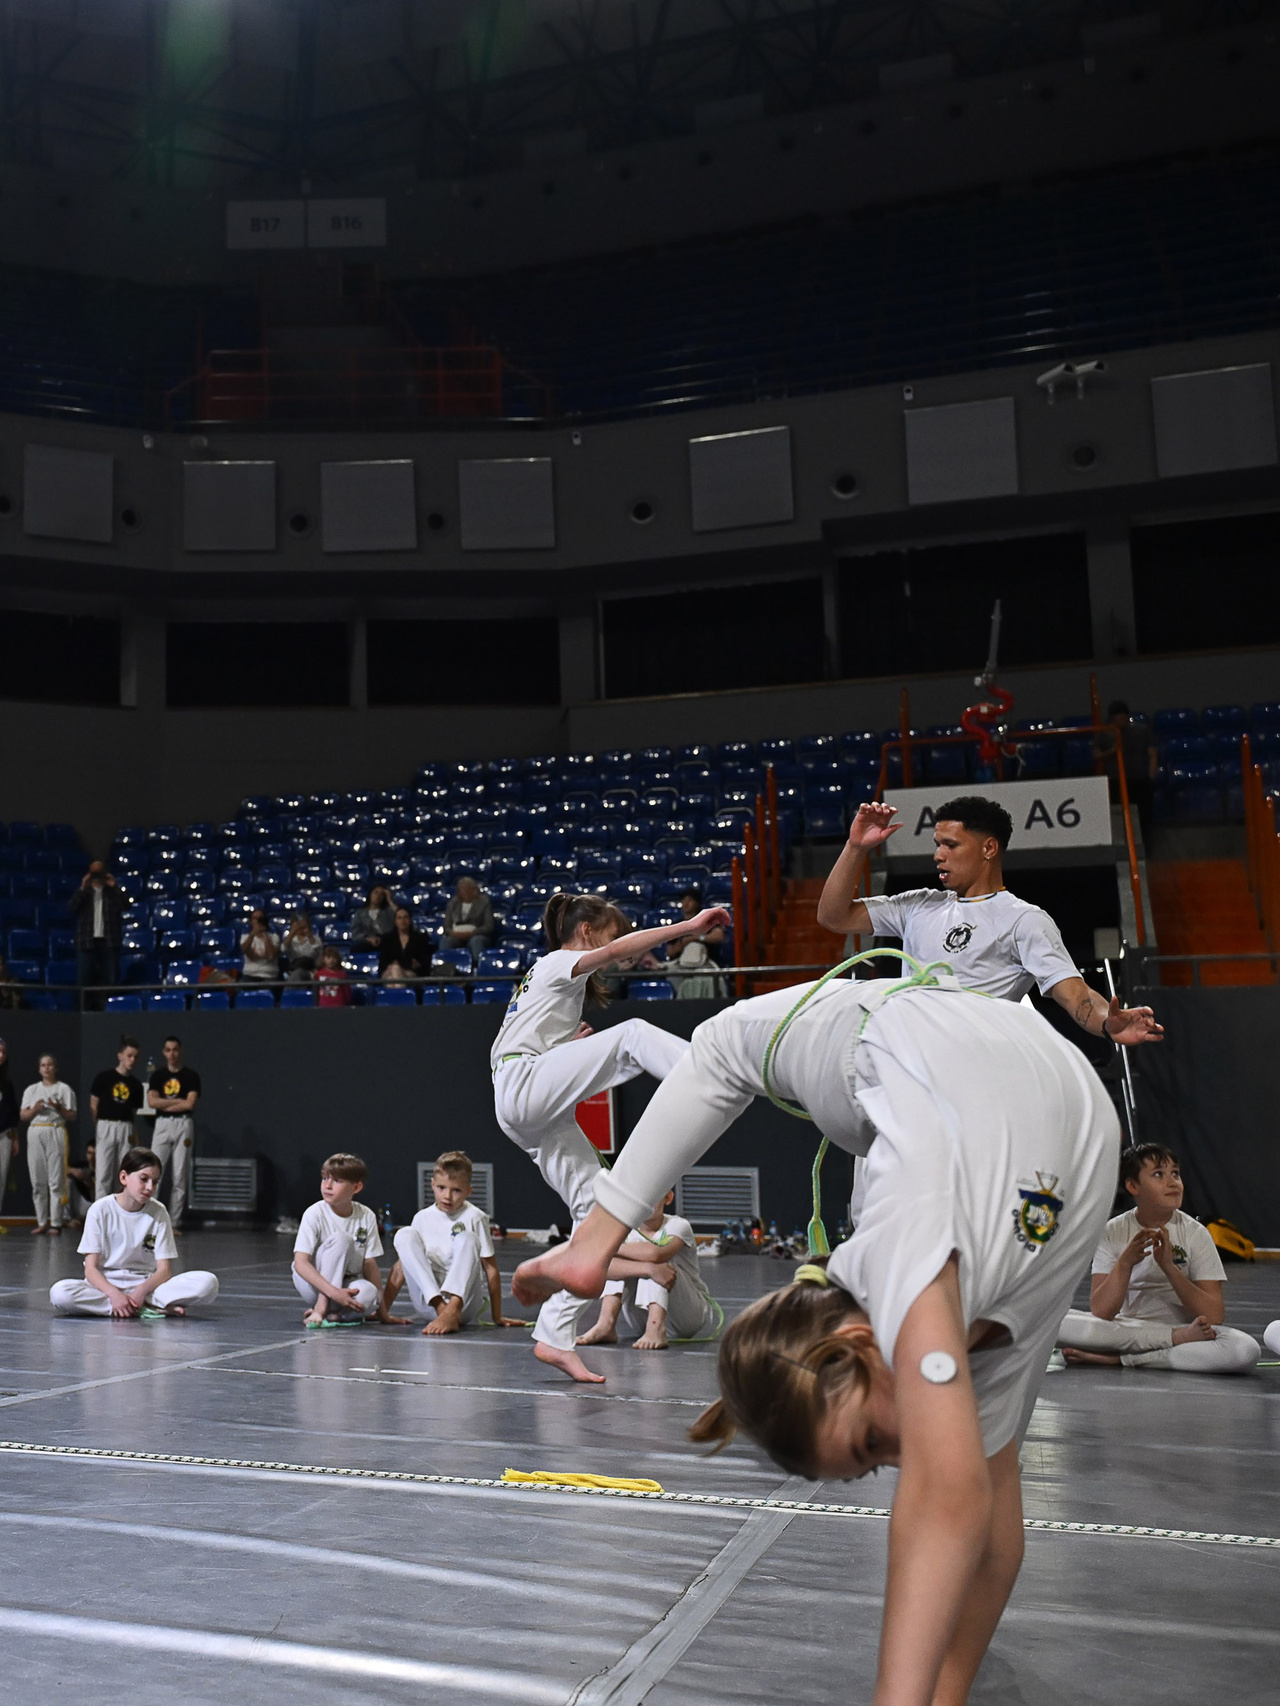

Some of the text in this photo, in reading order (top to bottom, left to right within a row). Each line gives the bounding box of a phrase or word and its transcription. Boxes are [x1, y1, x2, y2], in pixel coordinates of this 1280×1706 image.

[250, 217, 281, 232] B17
[330, 215, 363, 231] B16
[1024, 798, 1081, 831] A6
